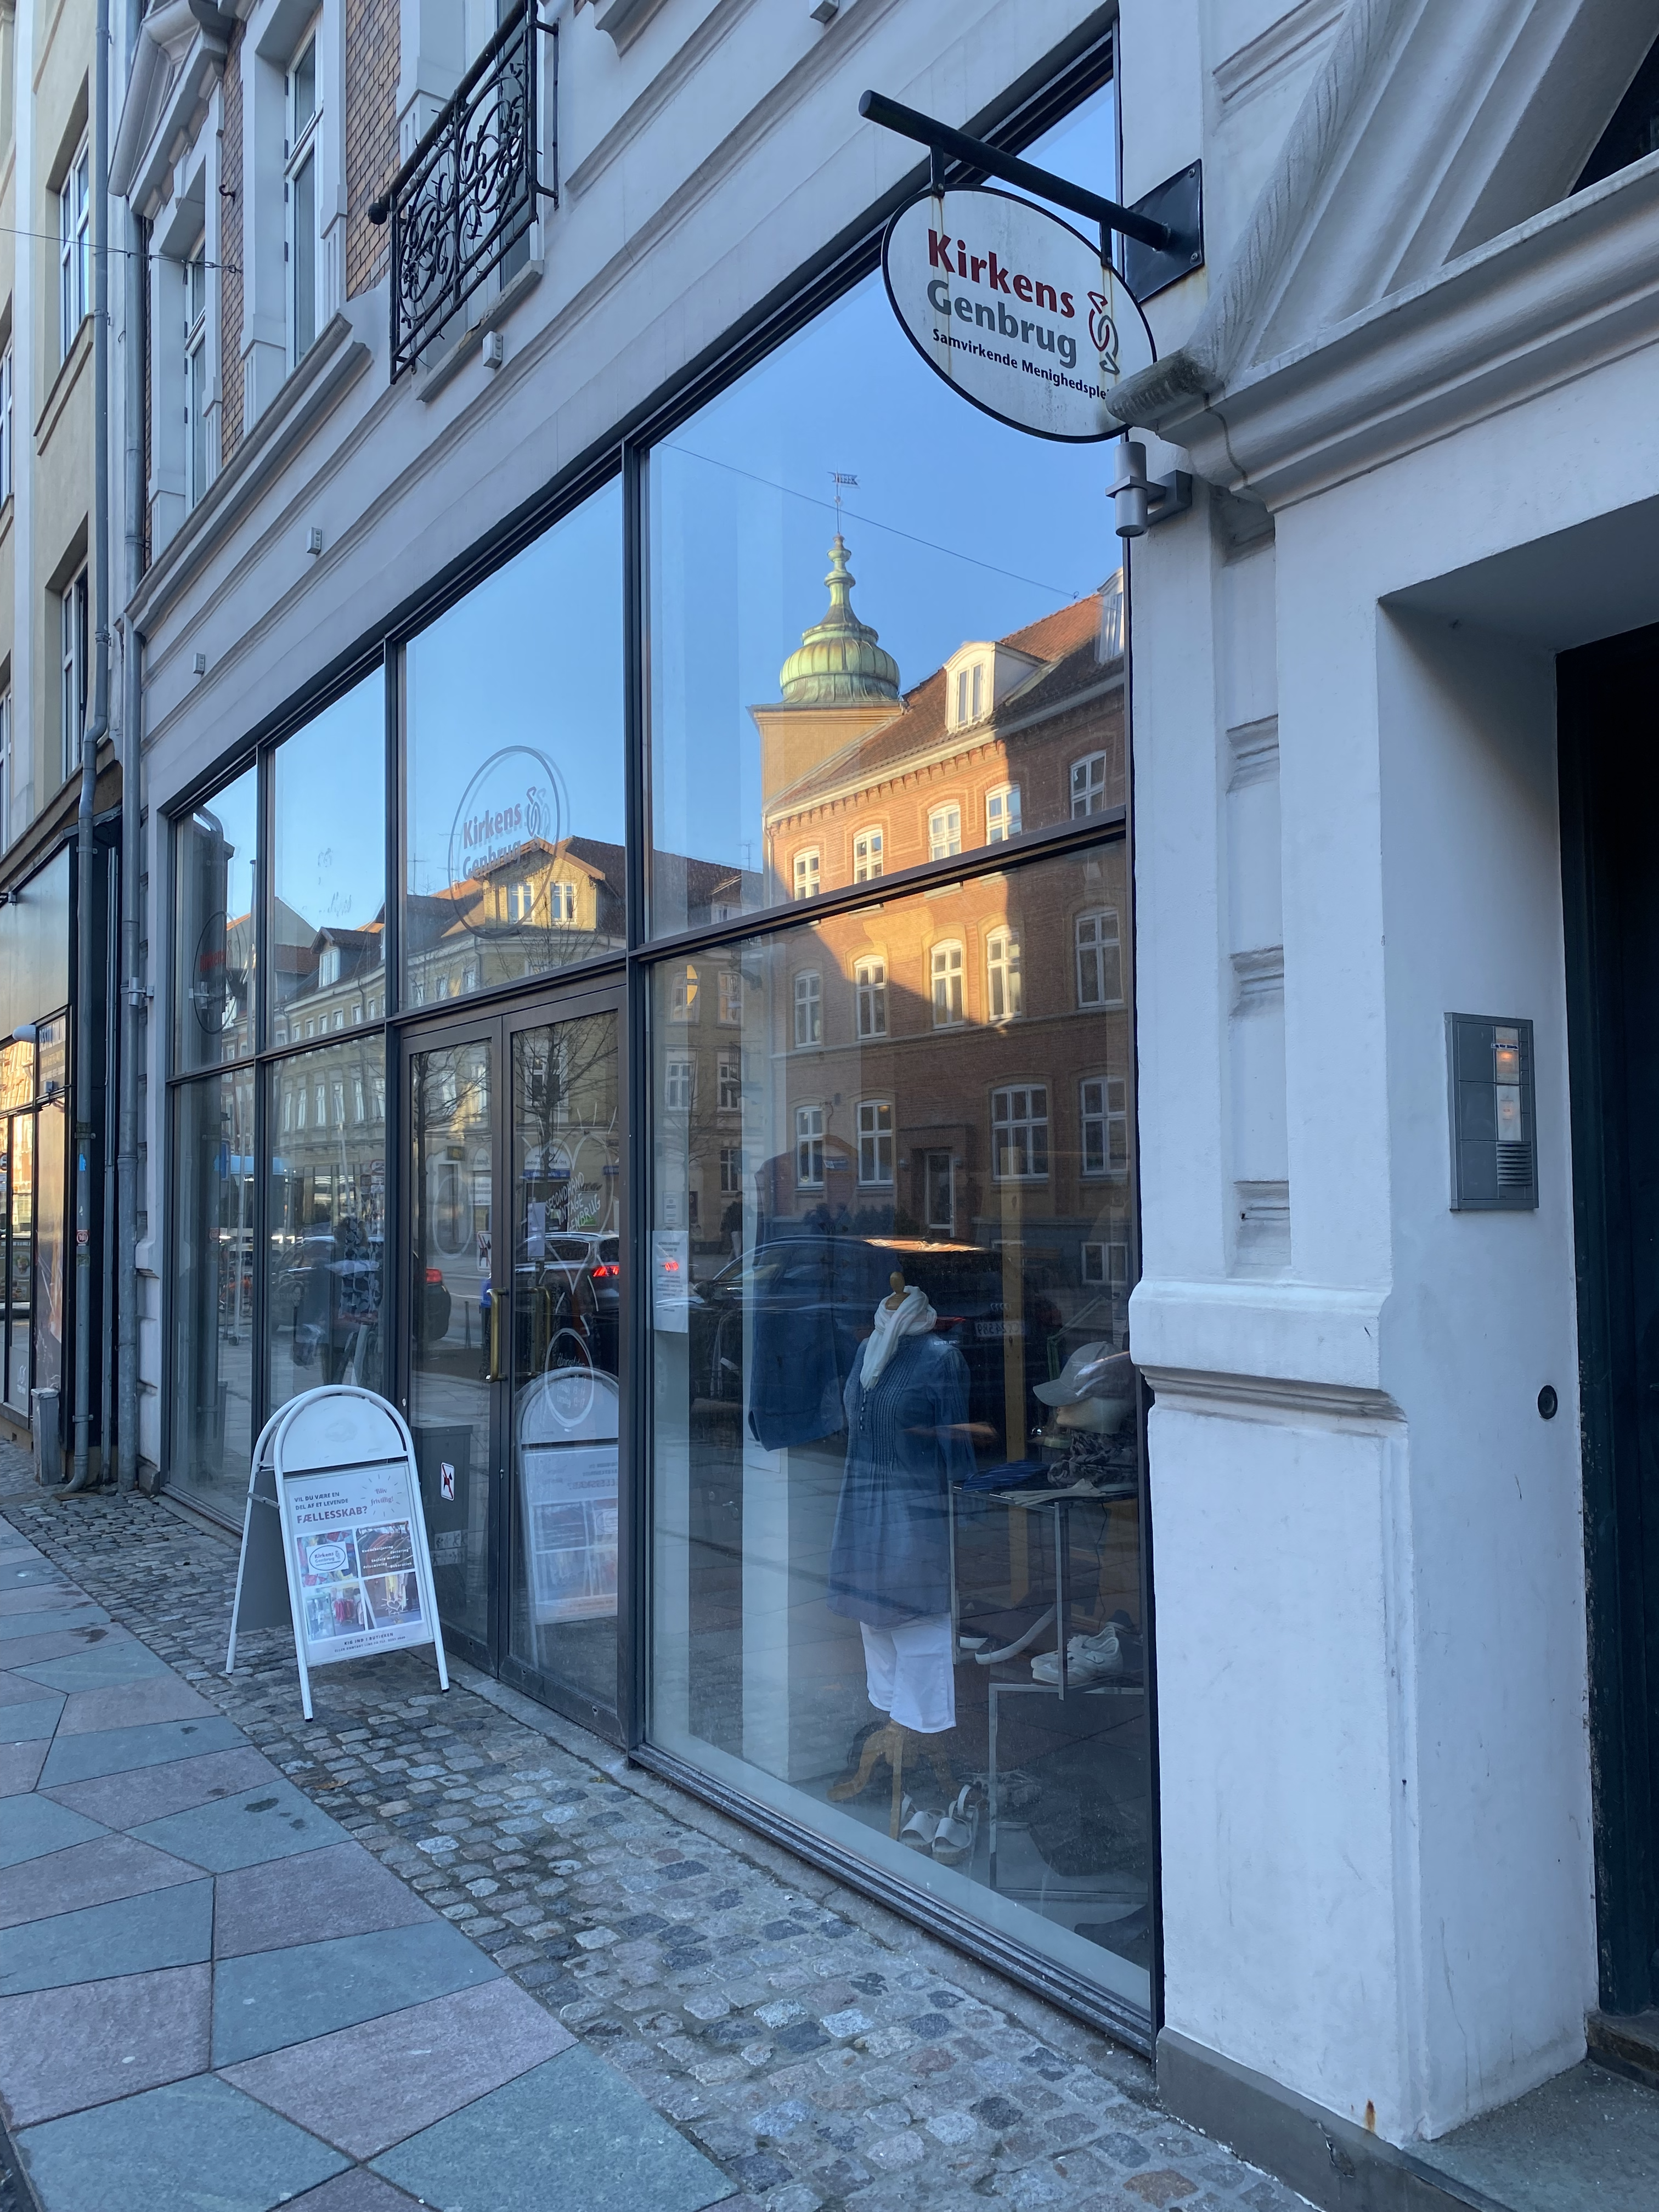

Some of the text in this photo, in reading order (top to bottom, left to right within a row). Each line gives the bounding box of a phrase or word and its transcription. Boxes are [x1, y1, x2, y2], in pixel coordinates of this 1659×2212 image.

[928, 228, 1075, 318] Kirkens
[927, 279, 1076, 369] Genbrug
[933, 329, 1110, 400] Samvirkende Menighedsple
[464, 803, 521, 849] Kirkens
[545, 1171, 584, 1216] SECONDHAND
[556, 1193, 584, 1225] VINTAGE
[297, 1506, 368, 1523] FÆLLESSKAB?
[324, 1498, 348, 1506] LEVENDE
[370, 1496, 394, 1506] frivillig!
[369, 1632, 393, 1640] BUTIKKEN
